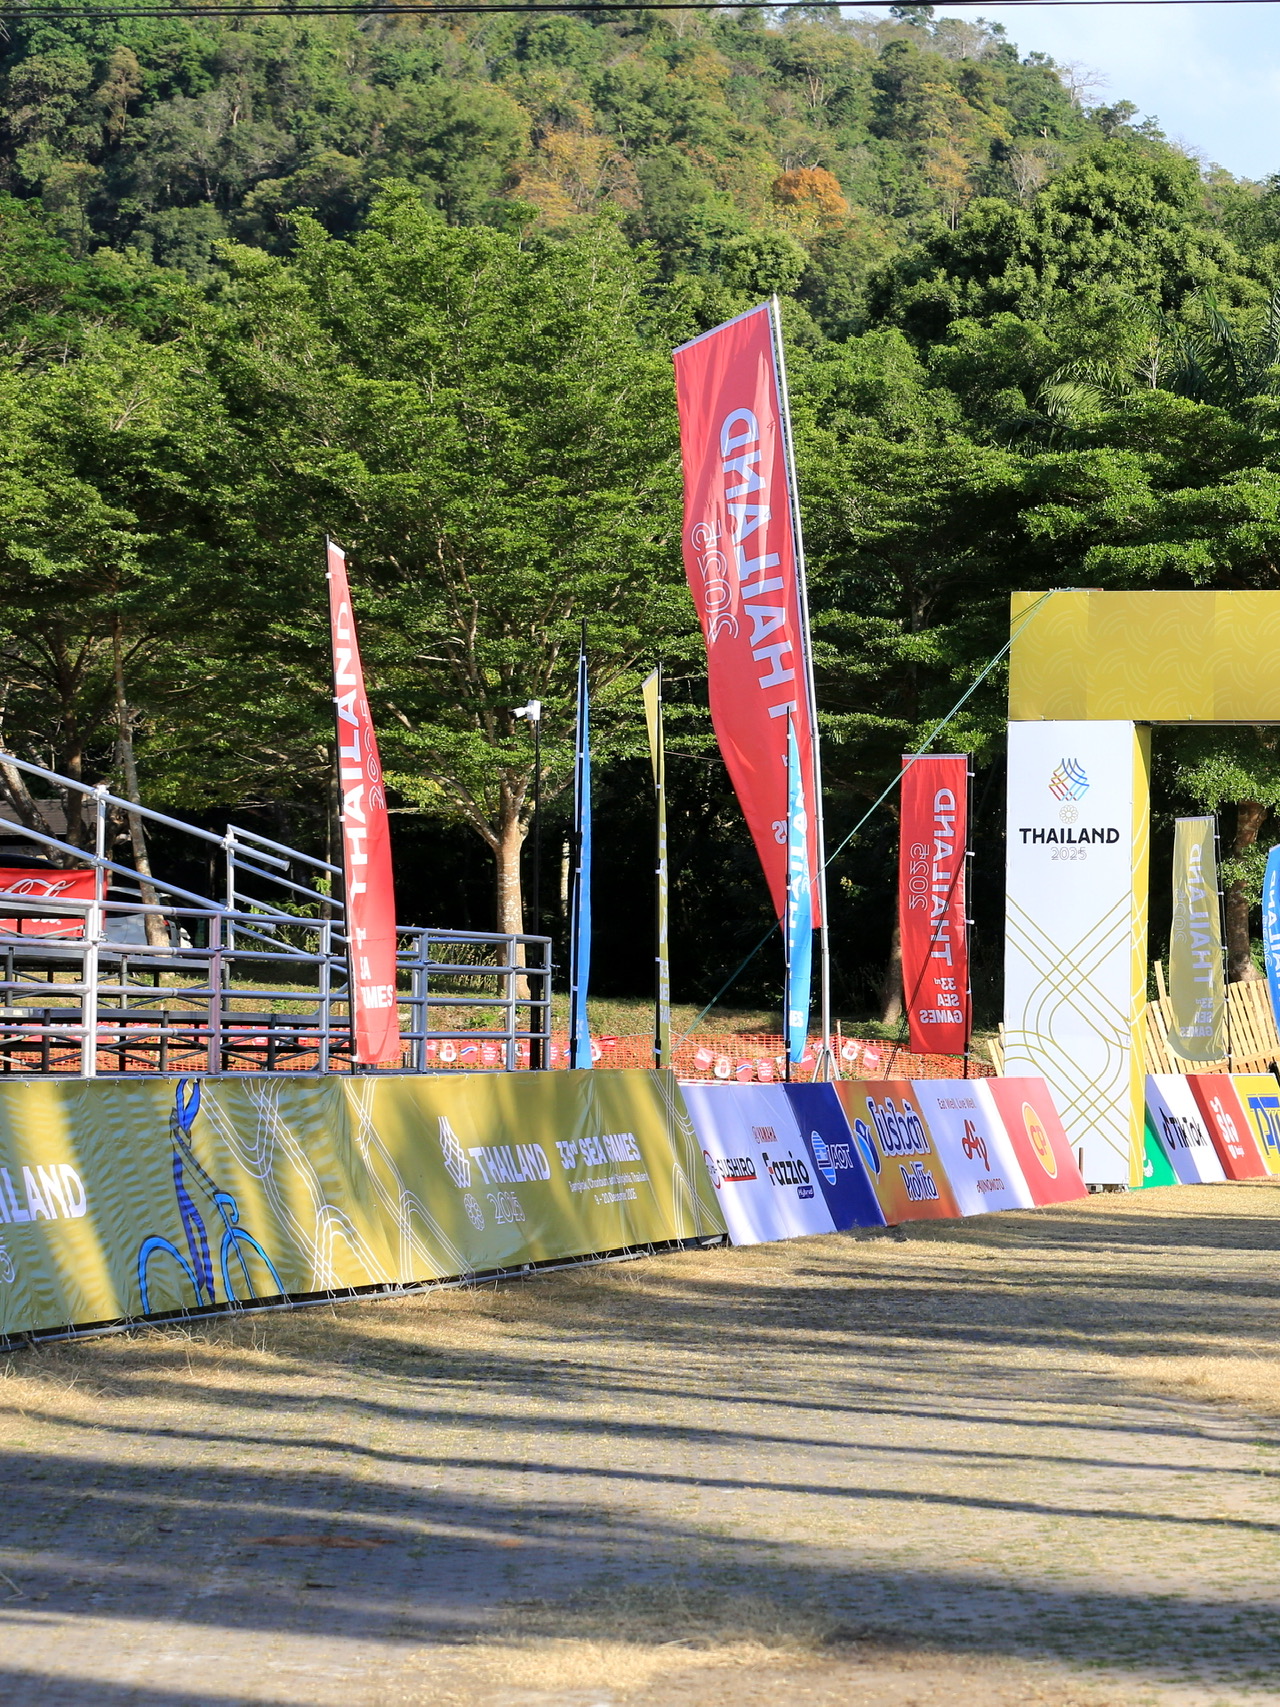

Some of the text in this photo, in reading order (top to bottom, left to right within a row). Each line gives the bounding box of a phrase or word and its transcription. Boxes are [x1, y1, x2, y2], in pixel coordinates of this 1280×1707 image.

[1019, 828, 1120, 844] THAILAND
[1051, 847, 1088, 861] 2025
[1031, 1125, 1047, 1156] CP
[1169, 1116, 1208, 1148] TikTok
[468, 1143, 551, 1185] THAILAND
[555, 1132, 641, 1170] 33rd SEA GAMES
[716, 1157, 757, 1179] SUSHIRO
[762, 1150, 810, 1186] Fazzio
[0, 1163, 87, 1224] ILAND
